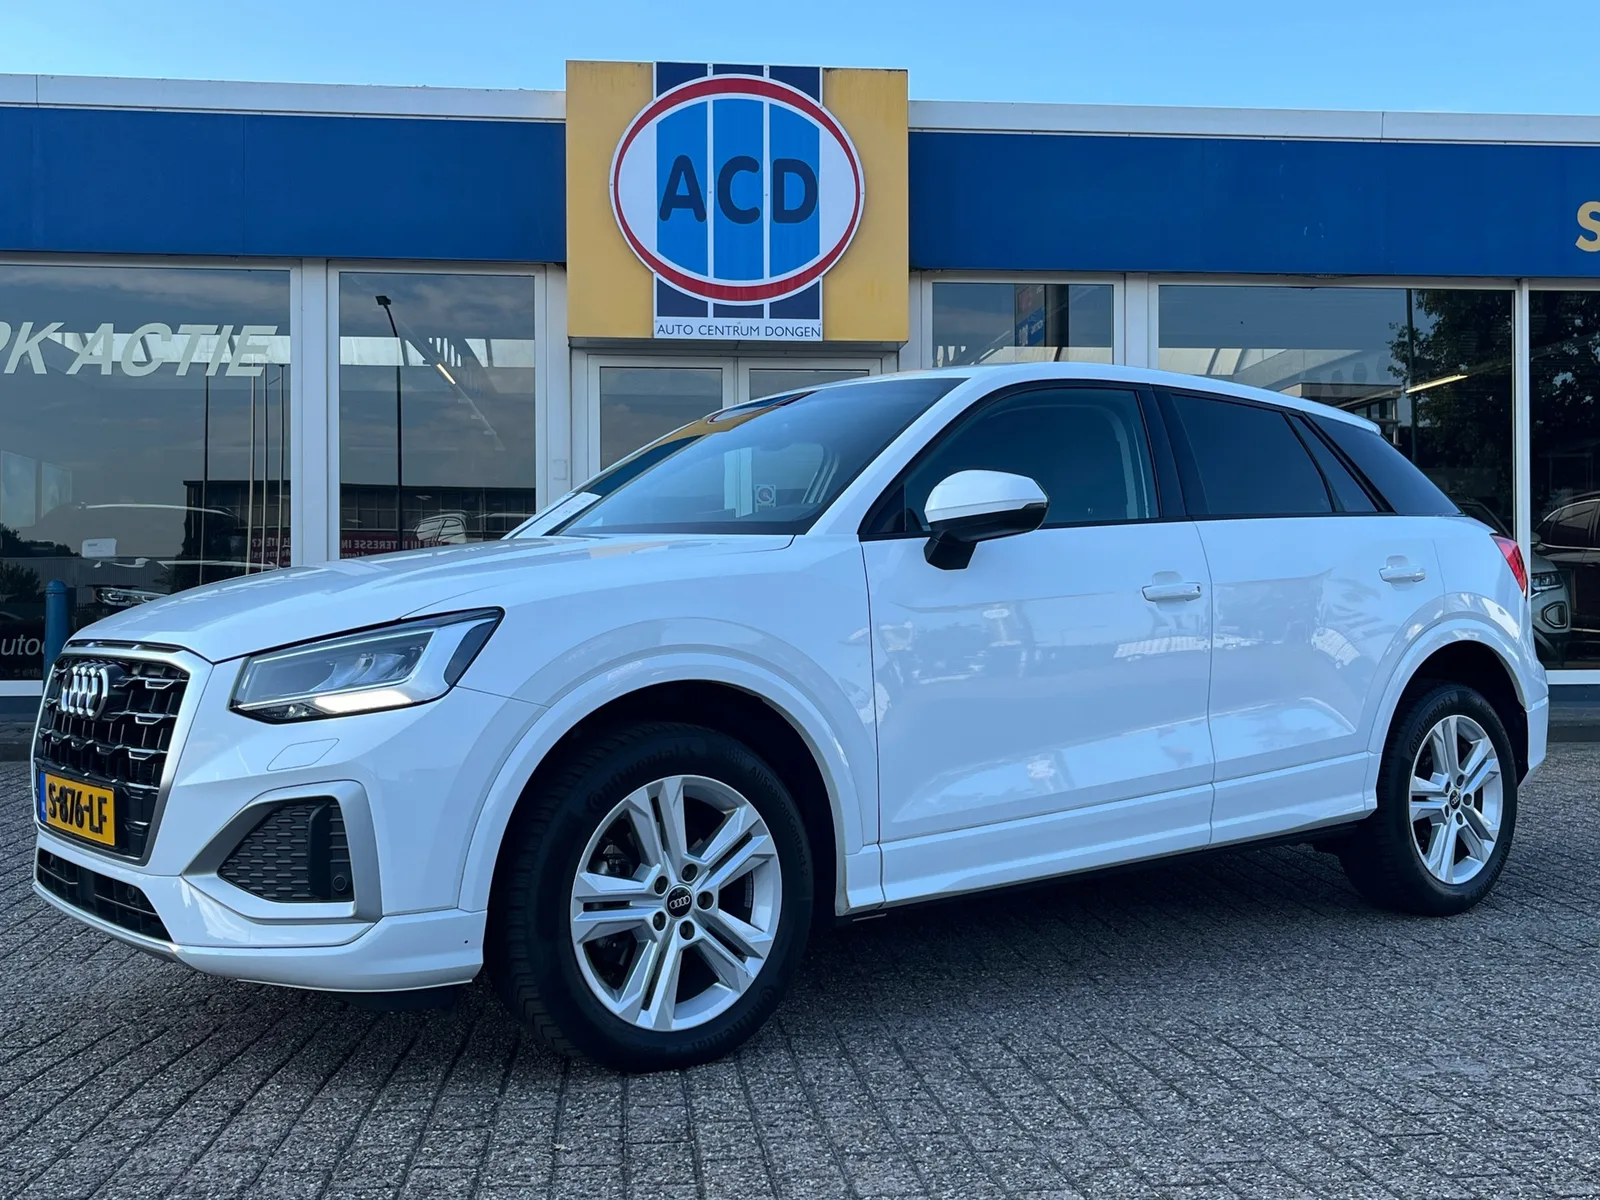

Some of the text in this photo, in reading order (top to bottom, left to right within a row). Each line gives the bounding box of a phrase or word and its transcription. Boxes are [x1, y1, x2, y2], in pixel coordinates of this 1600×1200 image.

[659, 154, 818, 224] ACD
[1575, 201, 1600, 252] S
[66, 322, 278, 377] ACTIE
[656, 324, 821, 338] AUTO CENTRUM DONGEN
[0, 634, 46, 656] uto
[48, 781, 107, 834] S-876-LF
